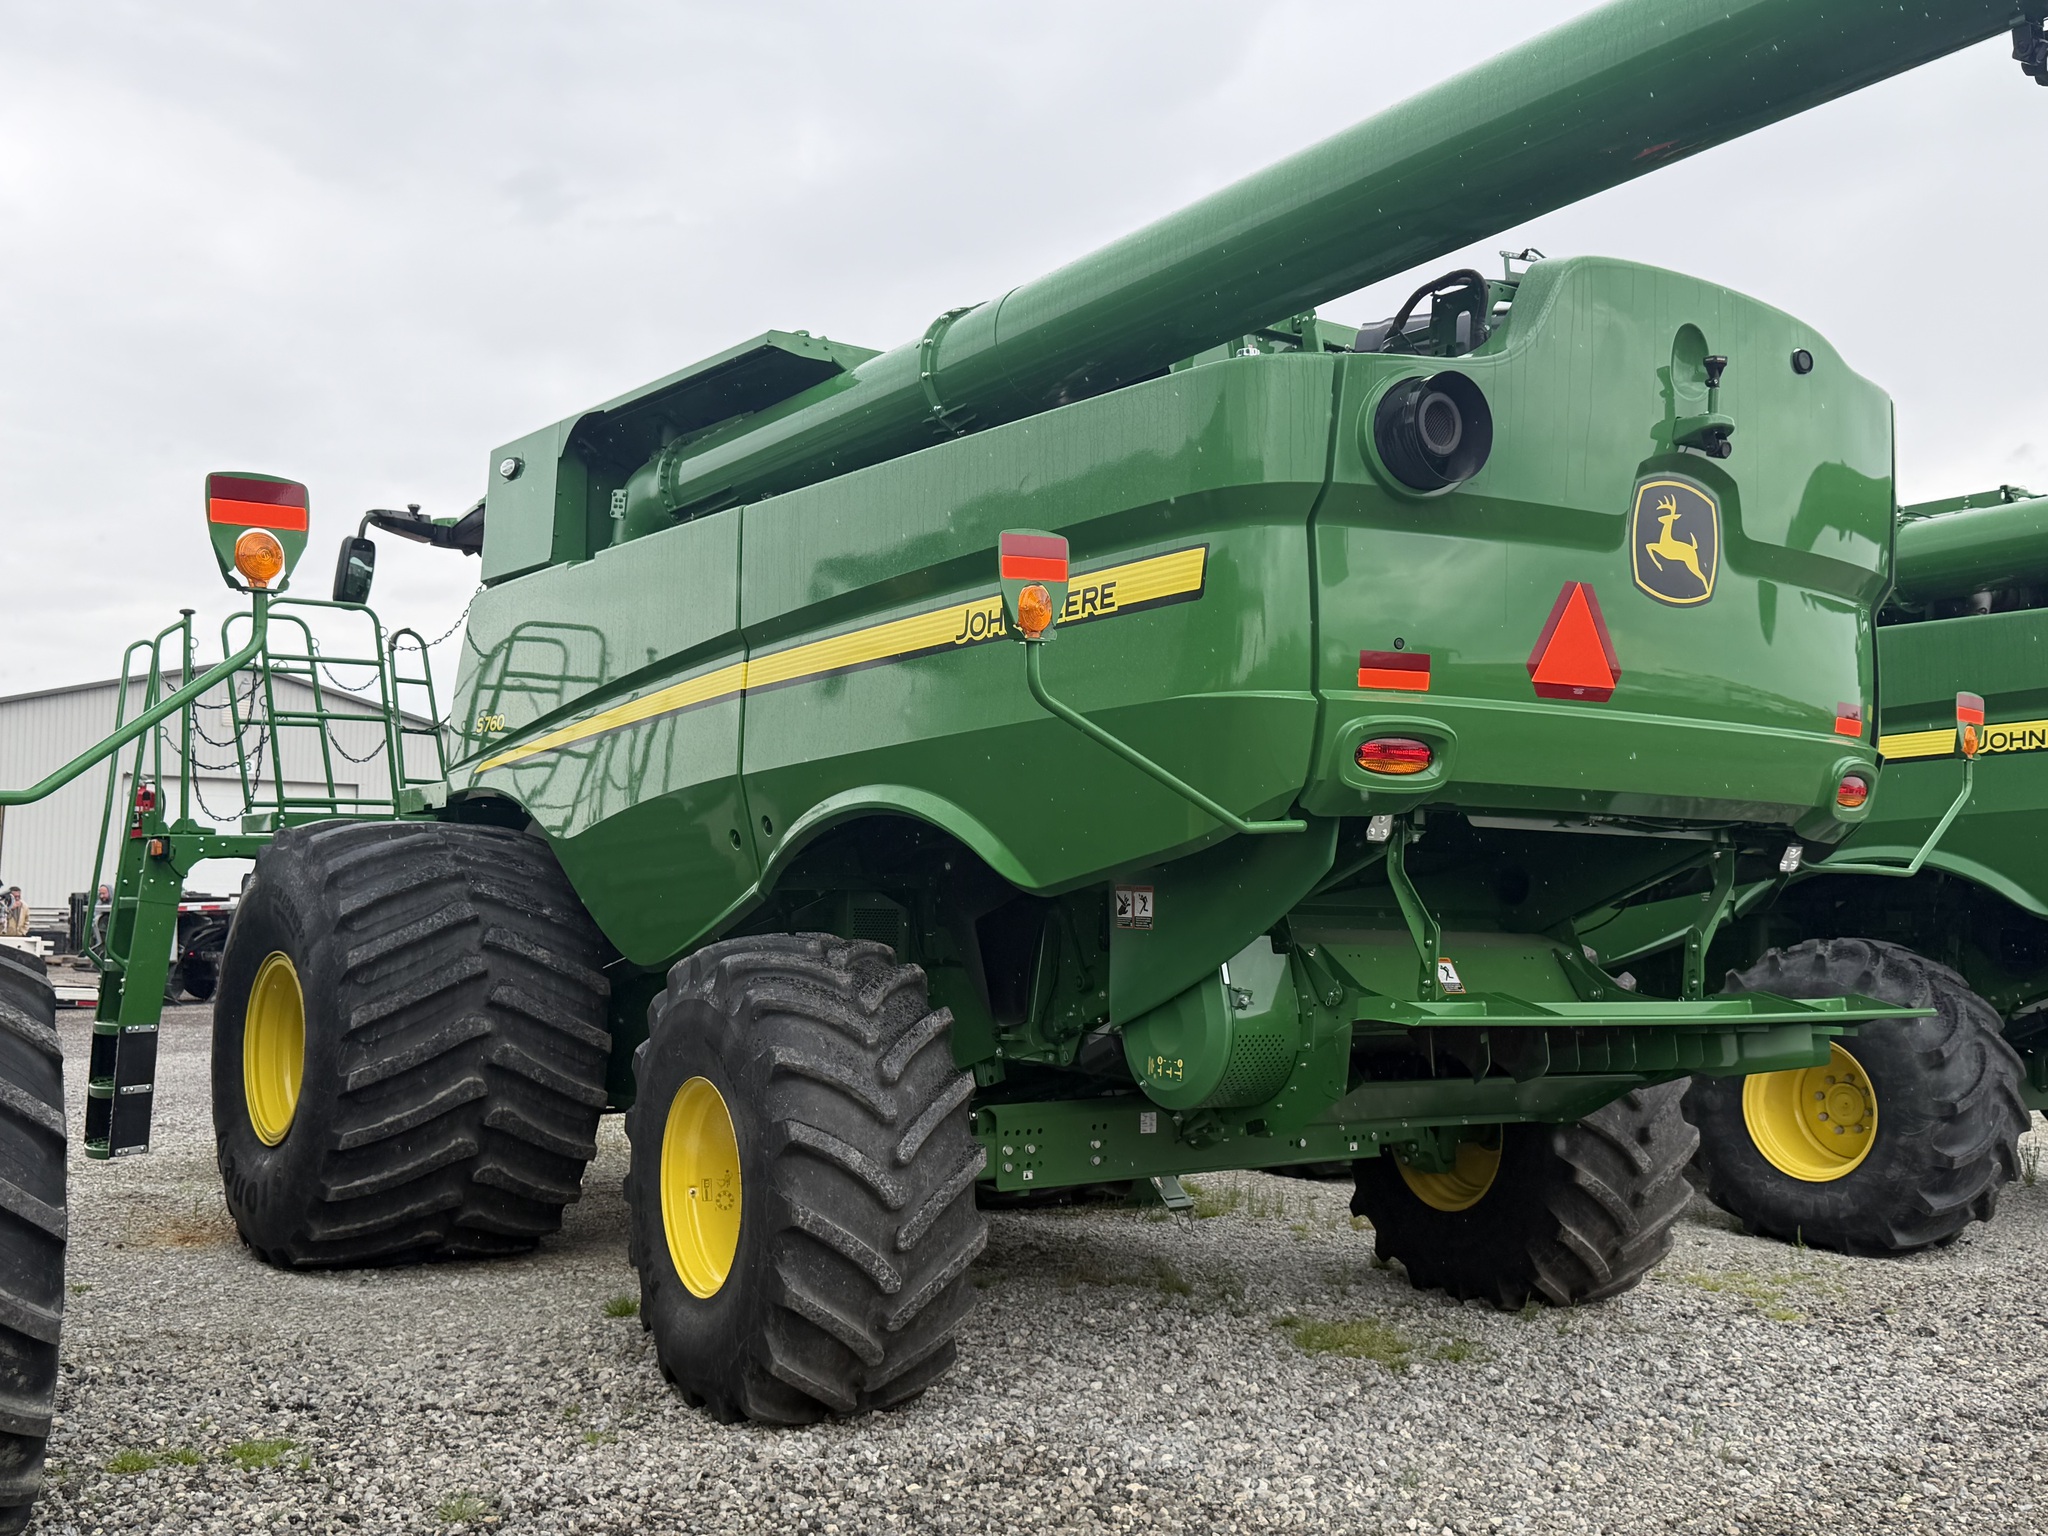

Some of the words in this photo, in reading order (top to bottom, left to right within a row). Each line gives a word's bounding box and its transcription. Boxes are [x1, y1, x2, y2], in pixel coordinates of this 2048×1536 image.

[956, 609, 1004, 640] JOH
[1059, 581, 1117, 618] ERE
[476, 713, 505, 734] S760
[1978, 728, 2046, 750] JOHN
